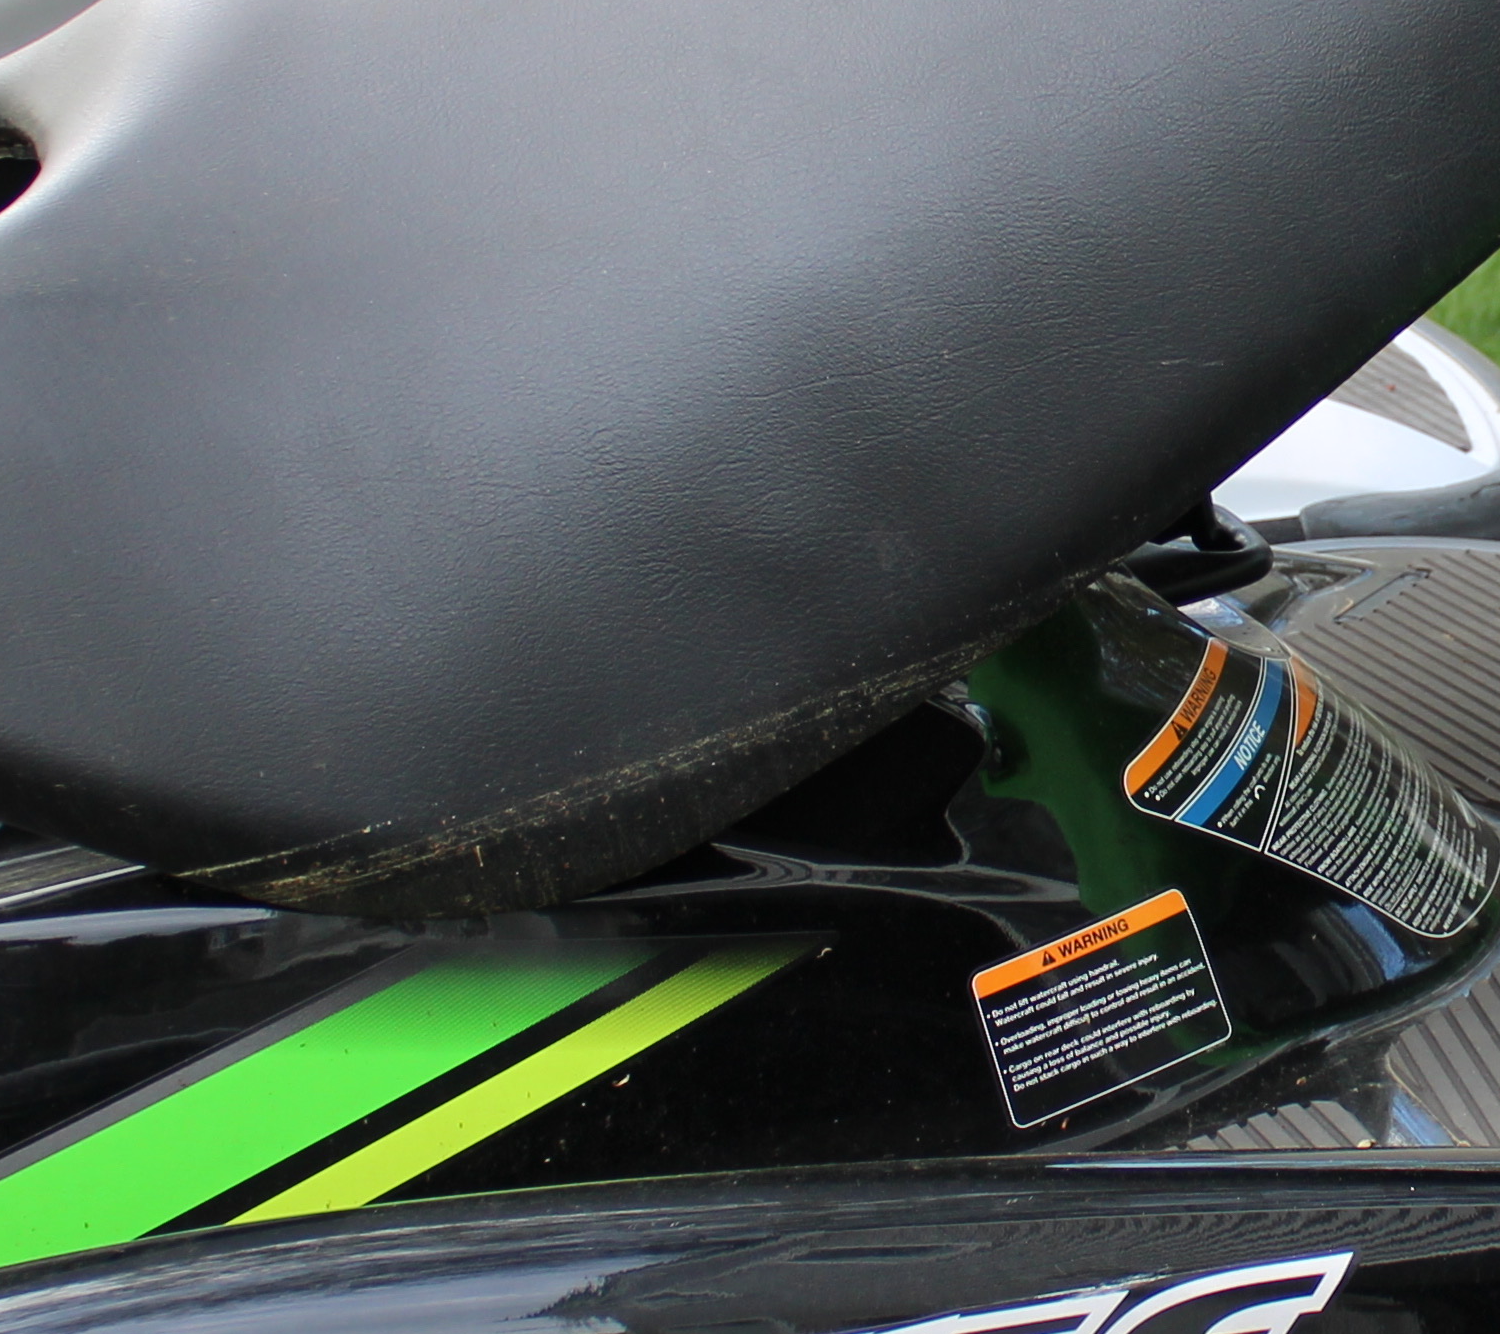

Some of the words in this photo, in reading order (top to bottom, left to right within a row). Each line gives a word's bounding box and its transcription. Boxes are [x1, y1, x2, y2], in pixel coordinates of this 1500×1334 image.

[1180, 667, 1217, 724] WARNING
[1233, 720, 1267, 771] NOTICE
[1058, 918, 1129, 958] WARNING
[991, 1009, 1004, 1019] Do
[1004, 1002, 1018, 1013] not
[1029, 981, 1068, 1002] watercraft
[1067, 973, 1089, 987] using
[994, 1005, 1035, 1027] Watercraft
[1035, 995, 1057, 1011] could
[1070, 984, 1085, 997] and
[1084, 975, 1106, 990] result
[1113, 962, 1137, 977] severe
[1003, 1042, 1024, 1055] make
[1024, 1024, 1063, 1046] watercraft
[1090, 1010, 1099, 1019] to
[1099, 997, 1125, 1015] control
[1125, 991, 1139, 1003] and
[1139, 982, 1159, 997] result
[1046, 1008, 1079, 1027] improper
[1079, 996, 1107, 1012] loading
[1138, 973, 1160, 987] heavy
[1159, 964, 1179, 977] items
[1178, 958, 1192, 969] can
[1008, 1059, 1033, 1074] Cargo
[1033, 1054, 1044, 1064] on
[1044, 1047, 1060, 1058] rear
[1060, 1039, 1080, 1052] deck
[1080, 1029, 1102, 1044] could
[1101, 1016, 1132, 1034] interfere
[1132, 1009, 1149, 1021] with
[1148, 992, 1186, 1014] reboarding
[1185, 988, 1195, 997] by
[1011, 1065, 1042, 1083] causing
[1048, 1055, 1065, 1067] loss
[1065, 1050, 1074, 1060] of
[1074, 1039, 1104, 1057] balance
[1105, 1031, 1119, 1044] and
[1119, 1019, 1149, 1038] possible
[1013, 1083, 1026, 1092] Do
[1025, 1076, 1039, 1087] not
[1039, 1068, 1060, 1082] stack
[1060, 1059, 1082, 1073] cargo
[1089, 1047, 1108, 1060] such
[1113, 1039, 1129, 1050] way
[1137, 1022, 1166, 1039] interfere
[1165, 1015, 1182, 1027] with
